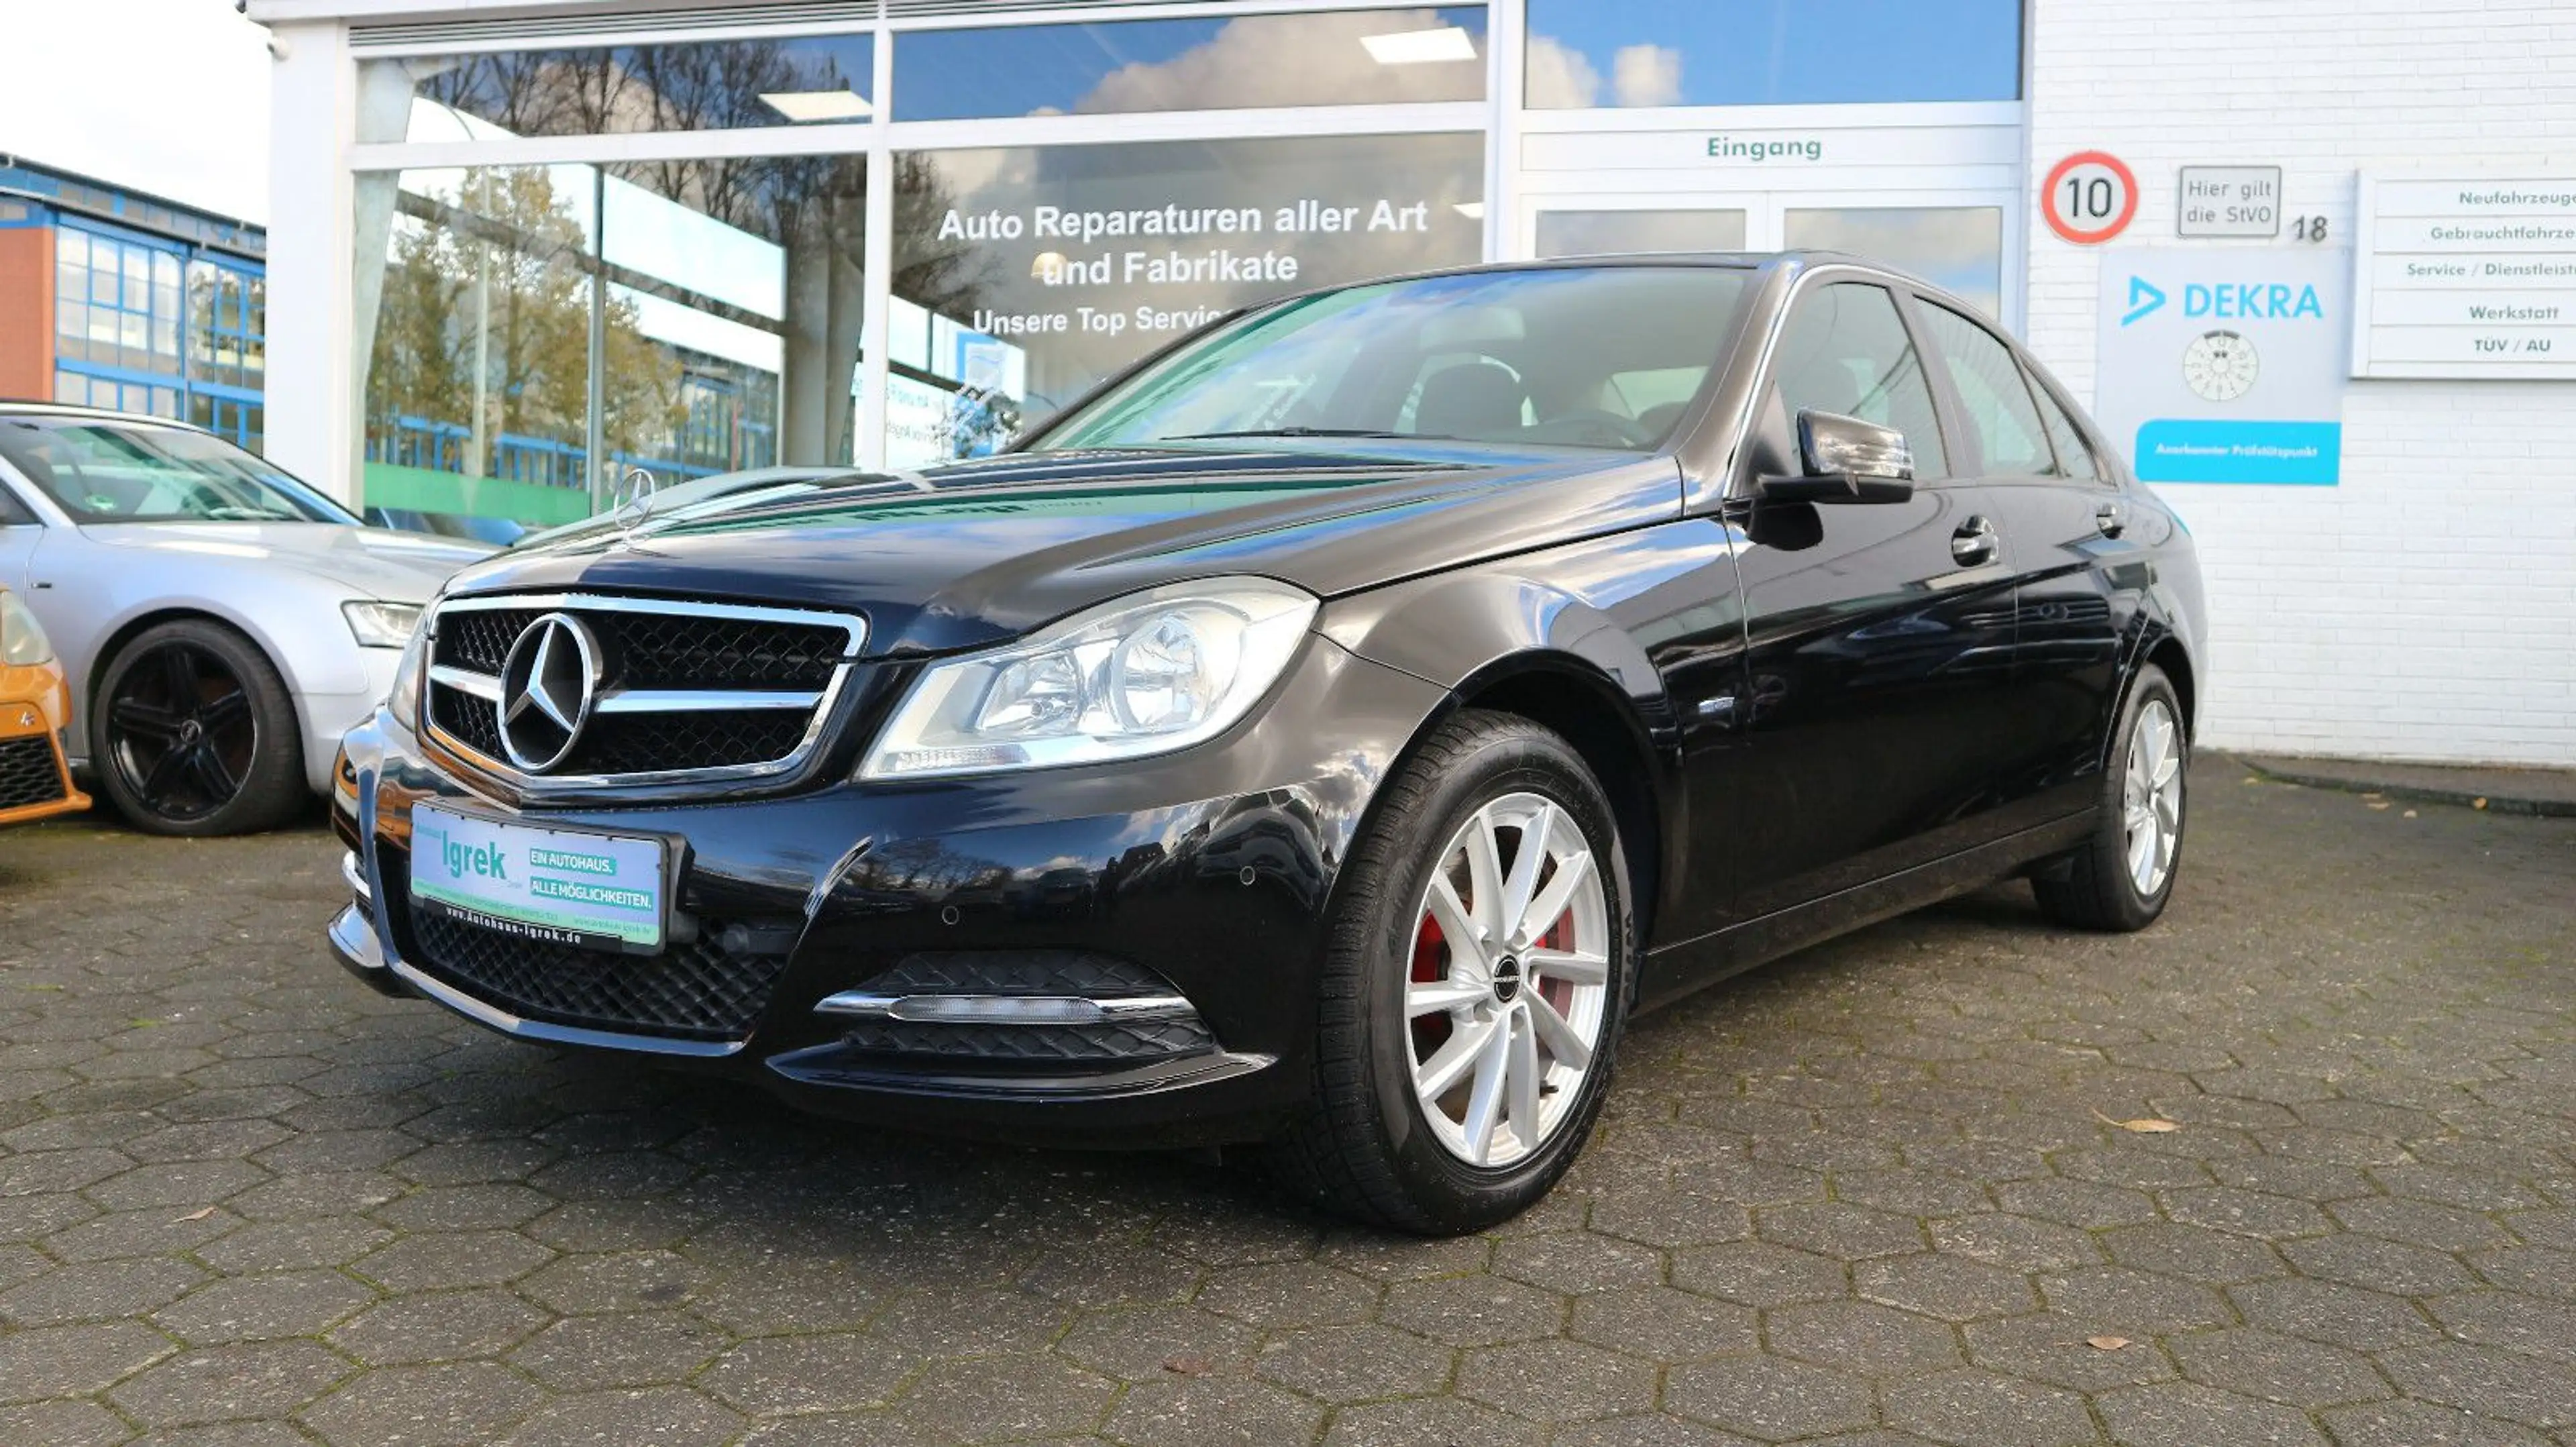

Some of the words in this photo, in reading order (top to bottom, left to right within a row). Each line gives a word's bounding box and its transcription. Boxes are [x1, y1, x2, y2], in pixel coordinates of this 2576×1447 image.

[1707, 137, 1821, 161] Eingang
[2066, 178, 2112, 218] 10
[2188, 180, 2229, 198] Hier
[2241, 179, 2271, 201] gilt
[938, 209, 1023, 241] Auto
[1034, 203, 1262, 243] Reparaturen
[1274, 200, 1358, 232] aller
[1366, 200, 1428, 231] Art
[2187, 206, 2216, 223] die
[2227, 206, 2271, 223] StVO
[2292, 215, 2328, 243] 18
[1042, 252, 1111, 287] und
[1124, 249, 1299, 284] Fabrikate
[2407, 262, 2467, 276] Service
[2485, 262, 2576, 276] Dienstleist
[2183, 283, 2324, 319] DEKRA
[2469, 305, 2559, 320] Werkstatt
[973, 309, 1068, 335] Unsere
[1077, 307, 1126, 336] Top
[1135, 305, 1233, 330] Servic
[2474, 336, 2508, 352] TÜV
[2526, 339, 2551, 352] AU
[443, 830, 506, 879] Igrek
[530, 850, 547, 866] EIN
[548, 853, 613, 873] AUTOHAUS.
[531, 879, 558, 896] ALLE
[558, 881, 652, 909] MÖGLICHKEITEN.
